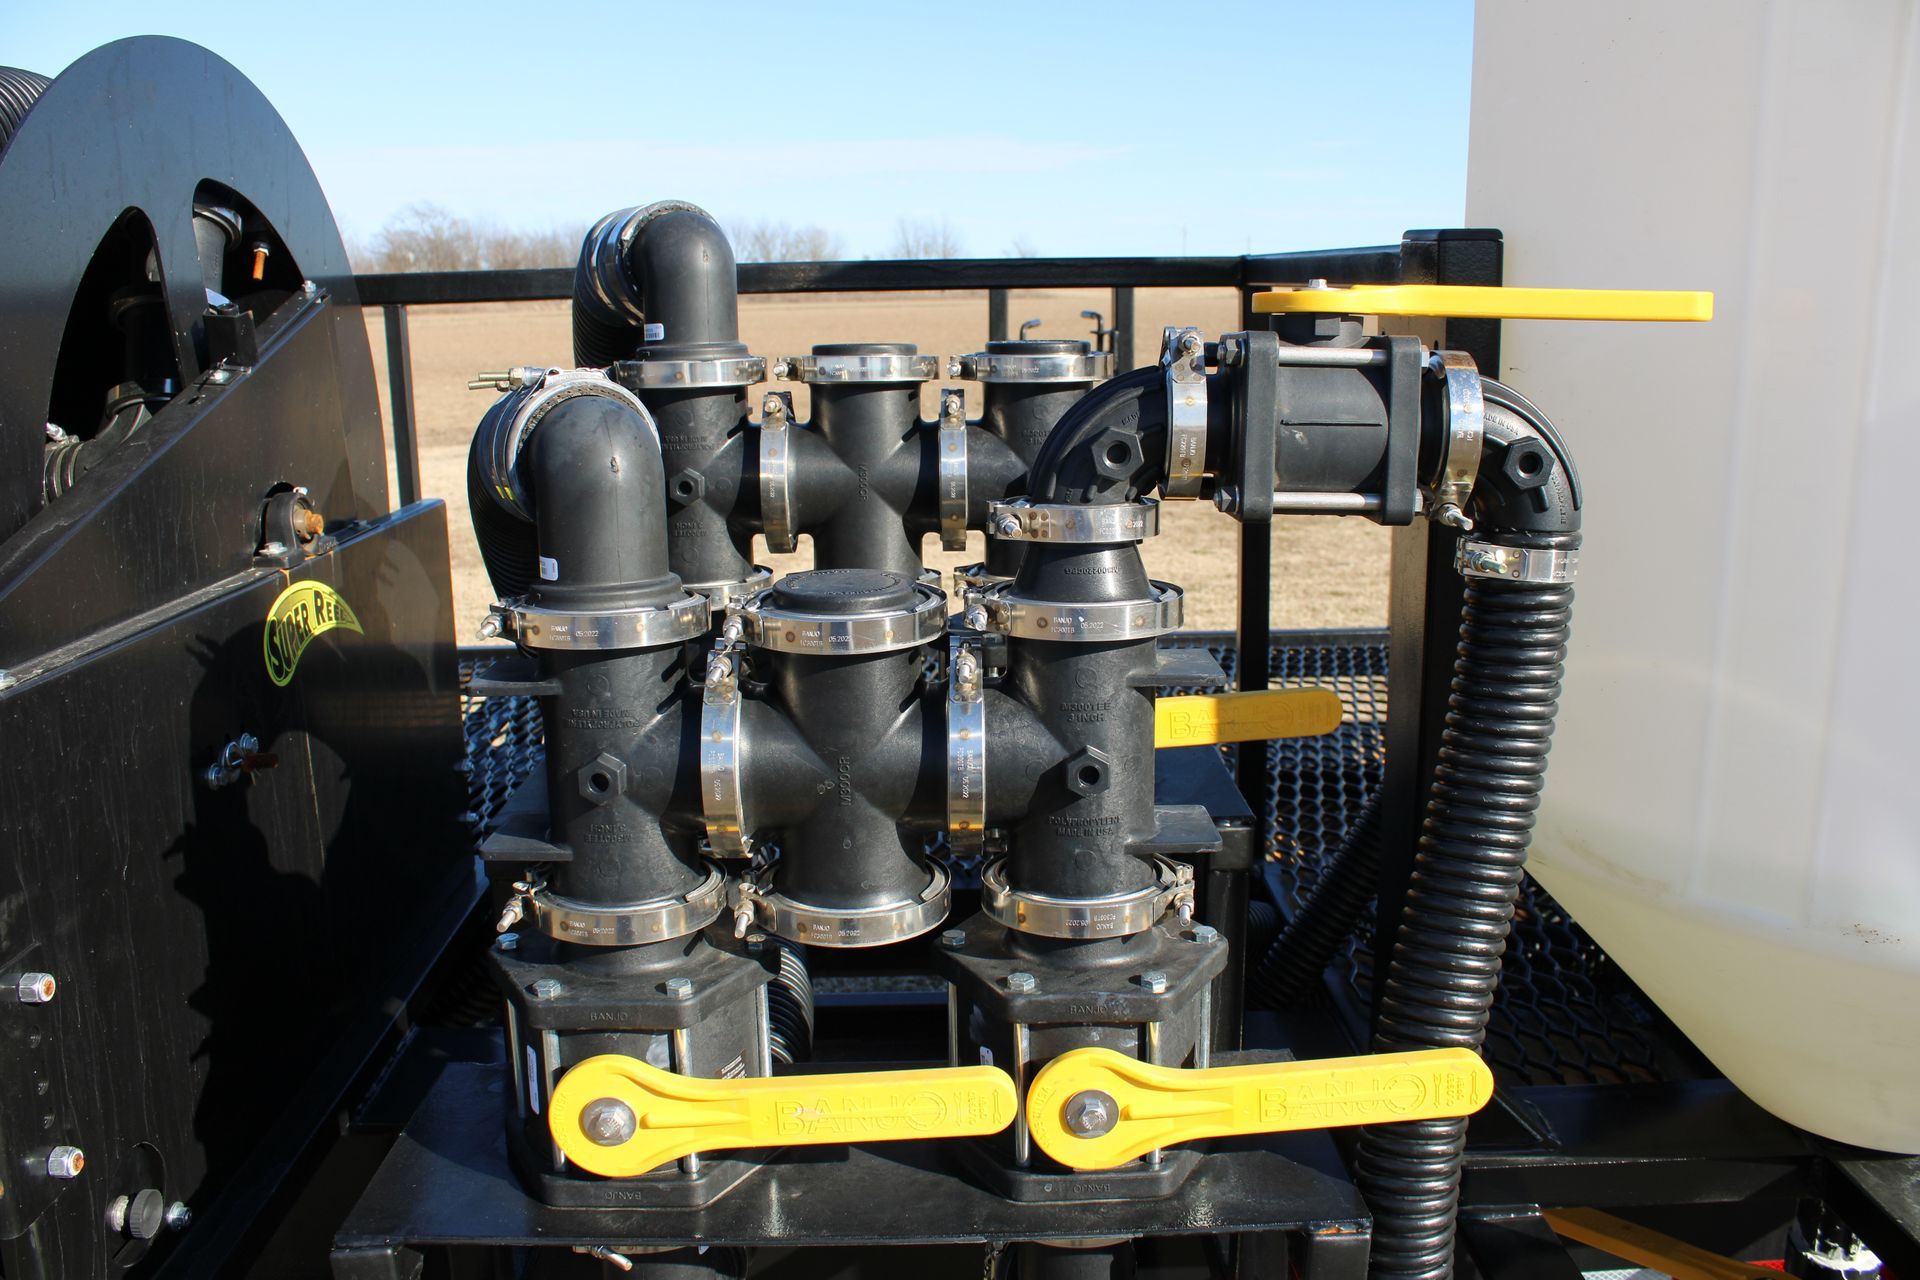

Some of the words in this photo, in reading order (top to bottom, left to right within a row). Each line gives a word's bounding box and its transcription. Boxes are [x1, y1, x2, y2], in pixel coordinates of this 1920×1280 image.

[267, 600, 313, 681] SUPER
[313, 587, 347, 627] REEL
[1168, 700, 1294, 740] BANJO
[590, 1012, 629, 1021] BANJO
[1070, 1004, 1108, 1015] BANJO
[774, 1090, 948, 1137] BANJO
[1258, 1073, 1427, 1124] BANJO
[604, 1191, 641, 1200] BANJO
